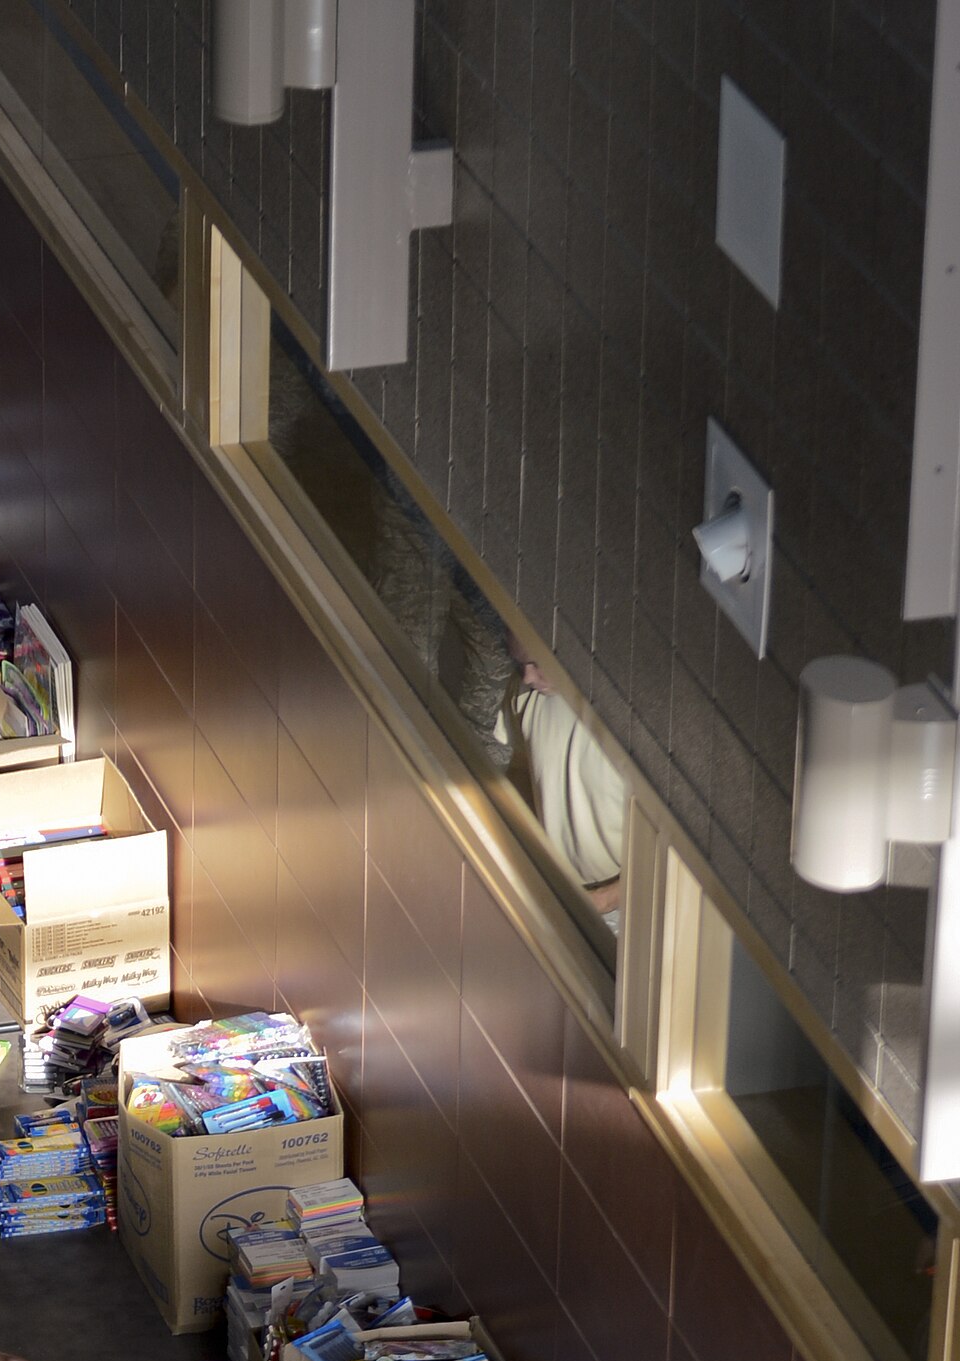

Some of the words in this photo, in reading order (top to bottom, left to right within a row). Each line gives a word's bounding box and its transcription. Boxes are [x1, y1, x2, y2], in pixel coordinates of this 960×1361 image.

[141, 905, 165, 917] 42192
[131, 1128, 161, 1153] 100762
[281, 1132, 329, 1149] 100762
[192, 1144, 253, 1161] Sofitelle
